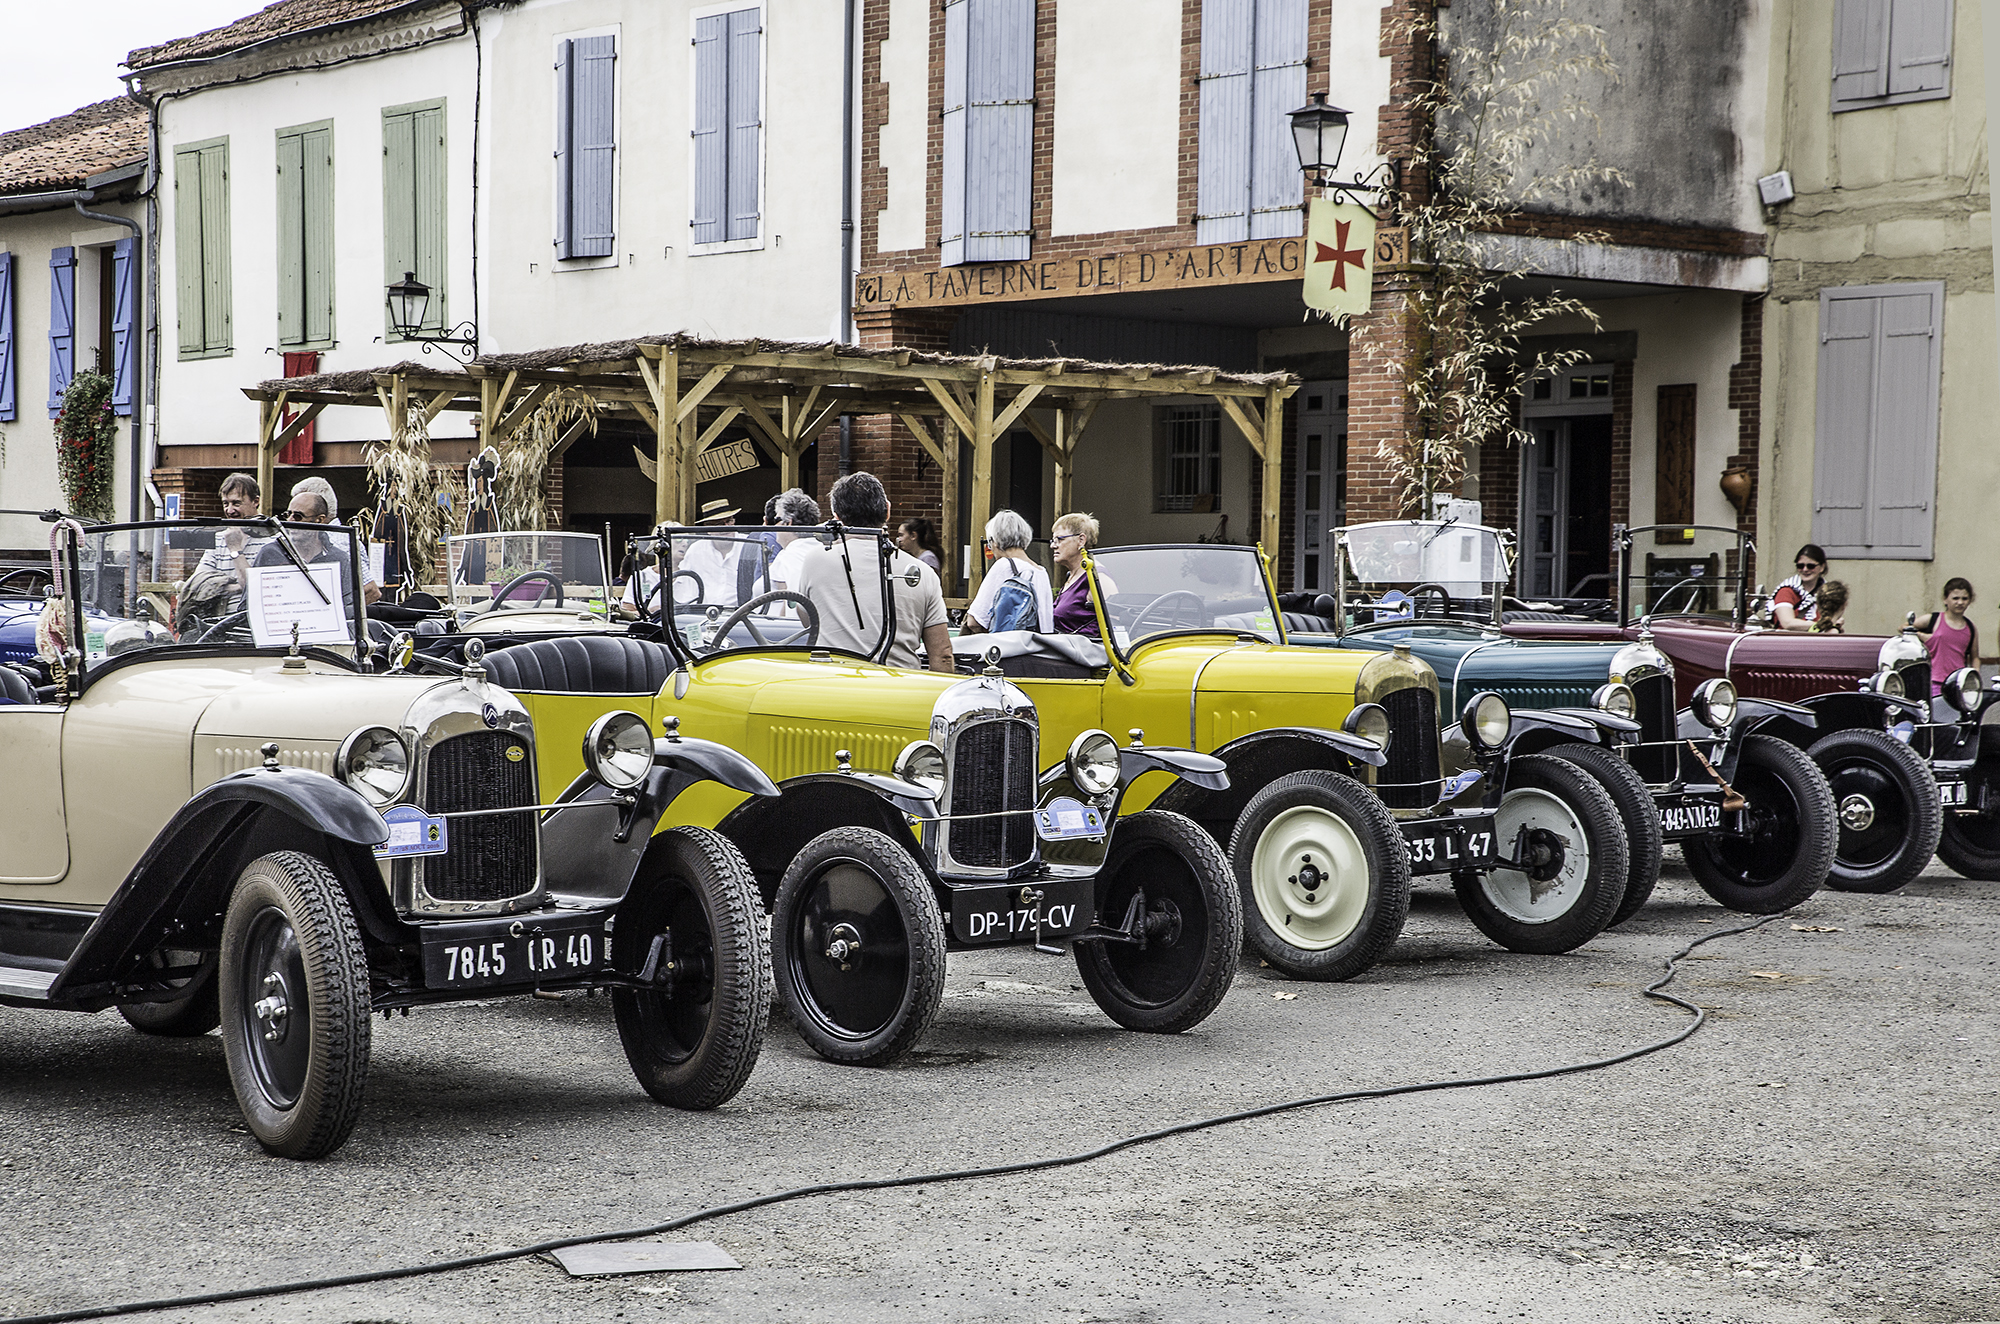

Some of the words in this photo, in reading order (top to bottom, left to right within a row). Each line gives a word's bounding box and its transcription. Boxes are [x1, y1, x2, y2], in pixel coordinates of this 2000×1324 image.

[877, 275, 915, 302] LA
[924, 262, 1057, 299] TAVERNE
[1076, 257, 1115, 288] DE
[1138, 239, 1308, 283] D'ARTAG
[1445, 836, 1459, 859] L
[1468, 832, 1491, 857] 47
[969, 904, 1076, 937] DP-179-CV
[444, 942, 506, 981] 7845
[566, 933, 592, 967] 40
